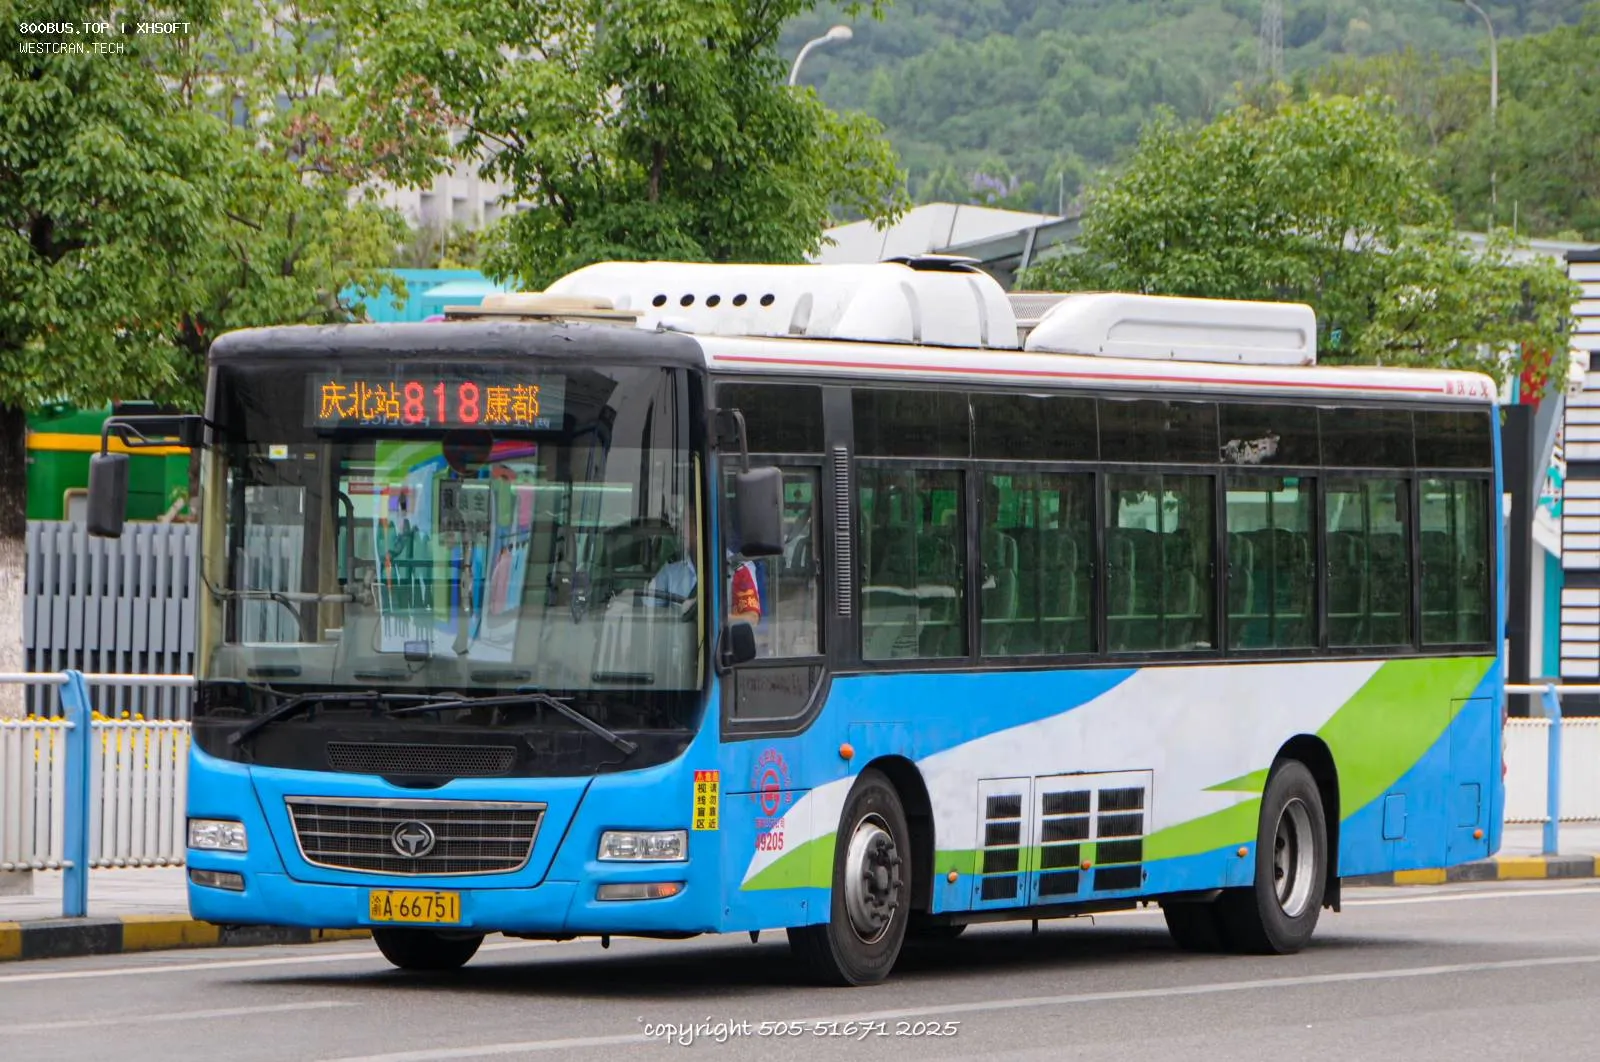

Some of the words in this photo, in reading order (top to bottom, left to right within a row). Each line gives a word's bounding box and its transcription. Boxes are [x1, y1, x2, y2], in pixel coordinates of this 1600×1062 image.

[319, 381, 401, 420] 庆北站
[403, 381, 480, 423] 818
[484, 383, 540, 423] 康都
